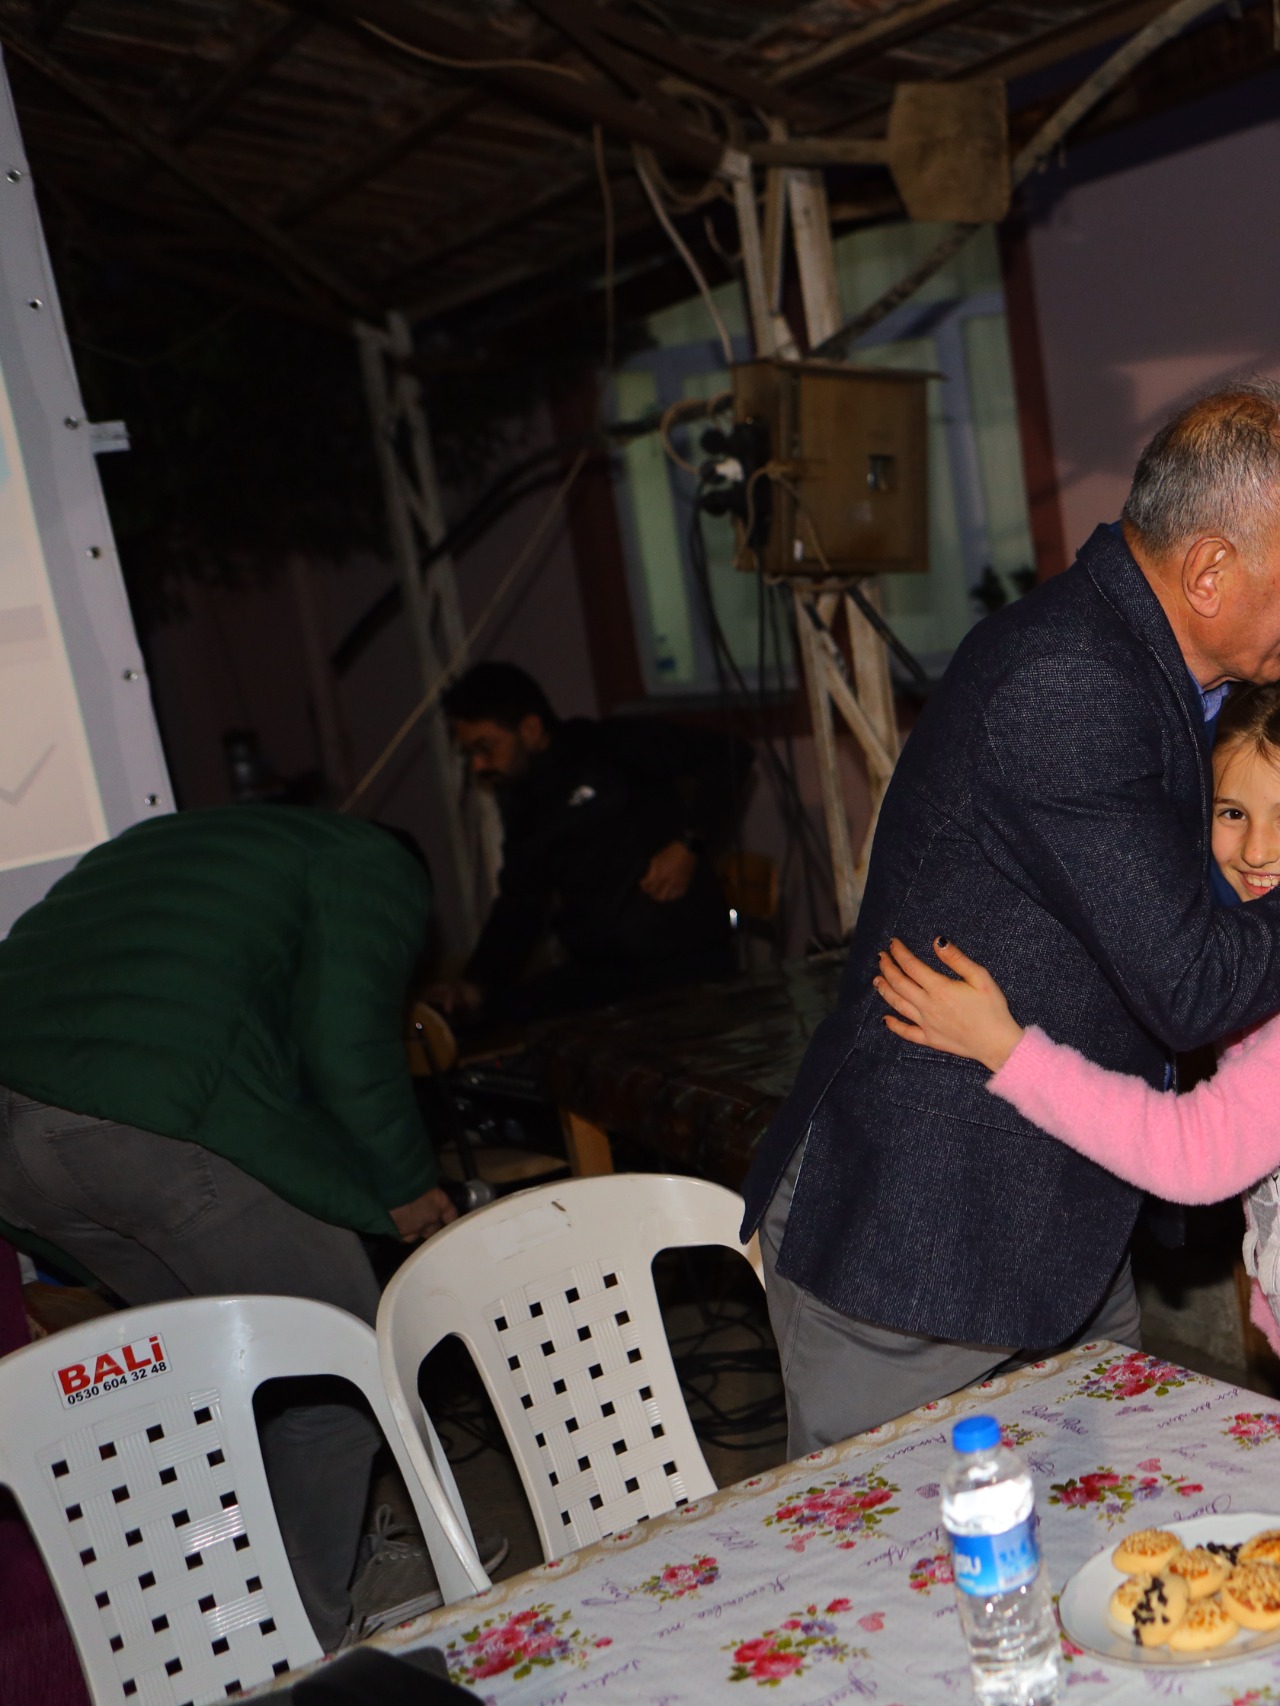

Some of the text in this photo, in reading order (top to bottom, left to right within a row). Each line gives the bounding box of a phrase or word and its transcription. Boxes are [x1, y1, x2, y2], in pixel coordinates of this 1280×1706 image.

[67, 1361, 167, 1405] 0530 604 32 48
